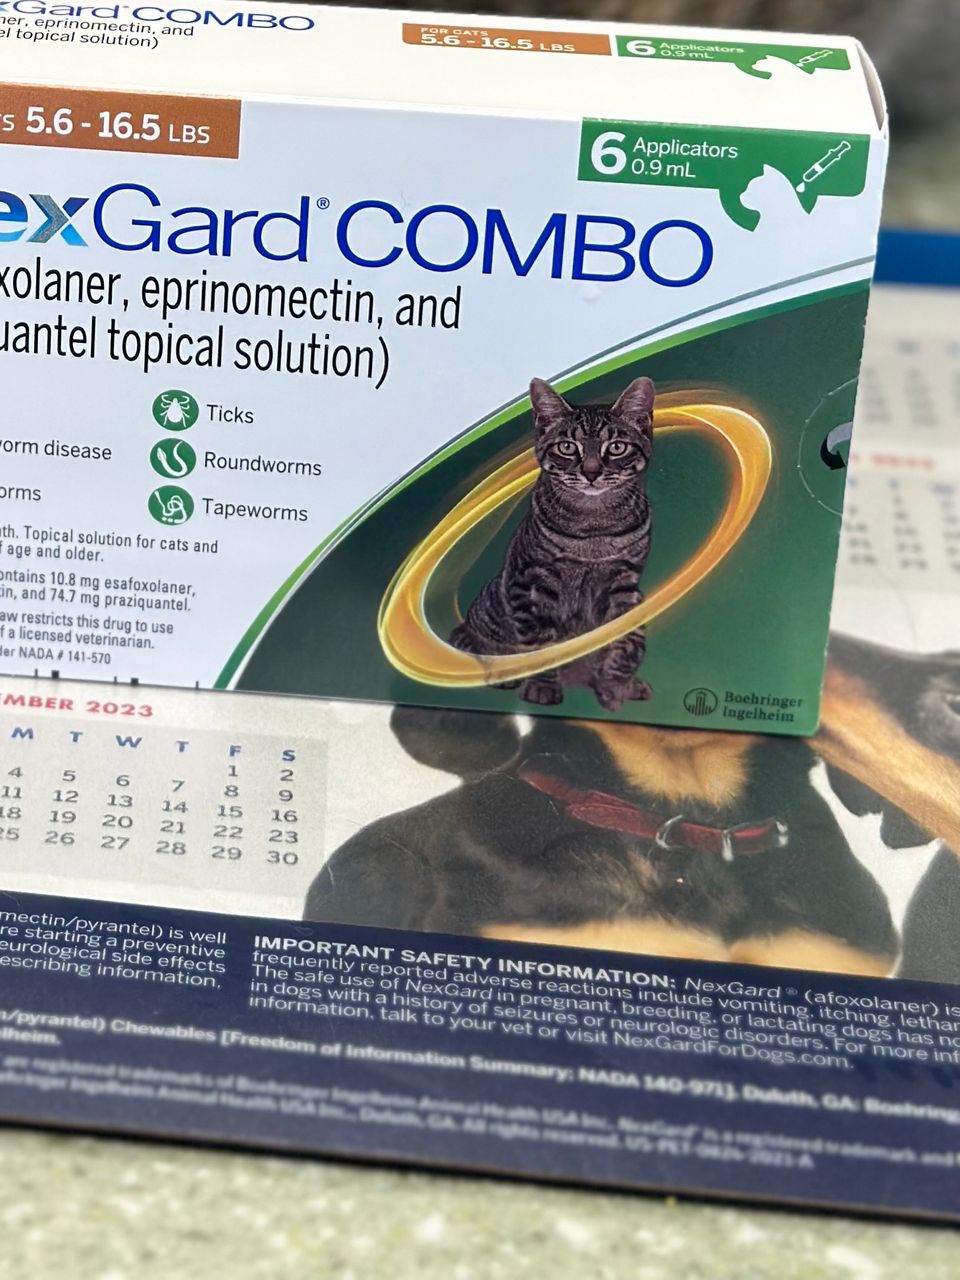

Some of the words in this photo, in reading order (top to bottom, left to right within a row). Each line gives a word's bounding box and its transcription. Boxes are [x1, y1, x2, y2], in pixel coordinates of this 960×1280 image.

[34, 16, 156, 35] eprinomectin,
[162, 24, 194, 37] and
[132, 6, 315, 32] COMBO
[16, 28, 75, 43] topical
[80, 32, 158, 49] solution)
[421, 34, 460, 46] 5.6
[482, 37, 533, 49] 16.5
[626, 40, 656, 55] 6
[659, 42, 744, 54] Applicators
[660, 49, 684, 58] 0.9
[688, 51, 713, 59] mL
[26, 106, 73, 135] 5.6
[99, 111, 161, 140] 16.5
[169, 124, 210, 143] LBS
[590, 131, 626, 175] 6
[633, 137, 738, 159] Applicators
[632, 159, 661, 176] 0.9
[666, 161, 696, 178] mL
[336, 199, 714, 288] COMBO
[141, 269, 382, 329] eprinomectin,
[396, 285, 462, 329] and
[107, 320, 223, 373] topical
[234, 328, 389, 389] solution)
[207, 404, 254, 424] Ticks
[44, 439, 112, 460] disease
[204, 452, 322, 477] Roundworms
[202, 498, 308, 522] Tapeworms
[24, 525, 73, 543] Topical
[78, 531, 131, 546] solution
[137, 534, 155, 548] for
[160, 538, 188, 551] cats
[194, 540, 218, 553] and
[7, 544, 31, 558] age
[37, 545, 60, 558] and
[66, 547, 104, 562] older.
[51, 572, 76, 586] 10.8
[80, 577, 99, 590] mg
[105, 577, 196, 597] esafoxolaner,
[22, 588, 46, 600] and
[51, 588, 76, 602] 74.7
[80, 593, 99, 607] mg
[105, 594, 191, 611] praziquantel.
[22, 611, 73, 626] restricts
[77, 615, 99, 629] this
[103, 617, 131, 633] drug
[136, 620, 147, 632] to
[152, 623, 173, 634] use
[8, 628, 15, 639] a
[19, 626, 71, 642] licensed
[76, 633, 154, 649] veterinarian.
[19, 646, 54, 660] NADA
[69, 651, 111, 664] 141-570
[86, 701, 154, 717] 2023
[725, 691, 804, 708] Boehringer
[723, 706, 794, 722] Ingelheim
[1, 786, 23, 799] 11
[54, 790, 79, 803] 12
[107, 795, 133, 808] 13
[163, 800, 188, 813] 14
[218, 805, 243, 819] 15
[272, 810, 298, 823] 16
[25, 927, 101, 947] starting
[106, 937, 117, 946] a
[123, 938, 225, 958] preventive
[169, 926, 183, 939] is
[190, 932, 226, 944] well
[254, 936, 395, 960] IMPORTANT
[401, 950, 492, 970] SAFETY
[498, 958, 676, 989] INFORMATION:
[804, 990, 938, 1017] (afoxolaner)
